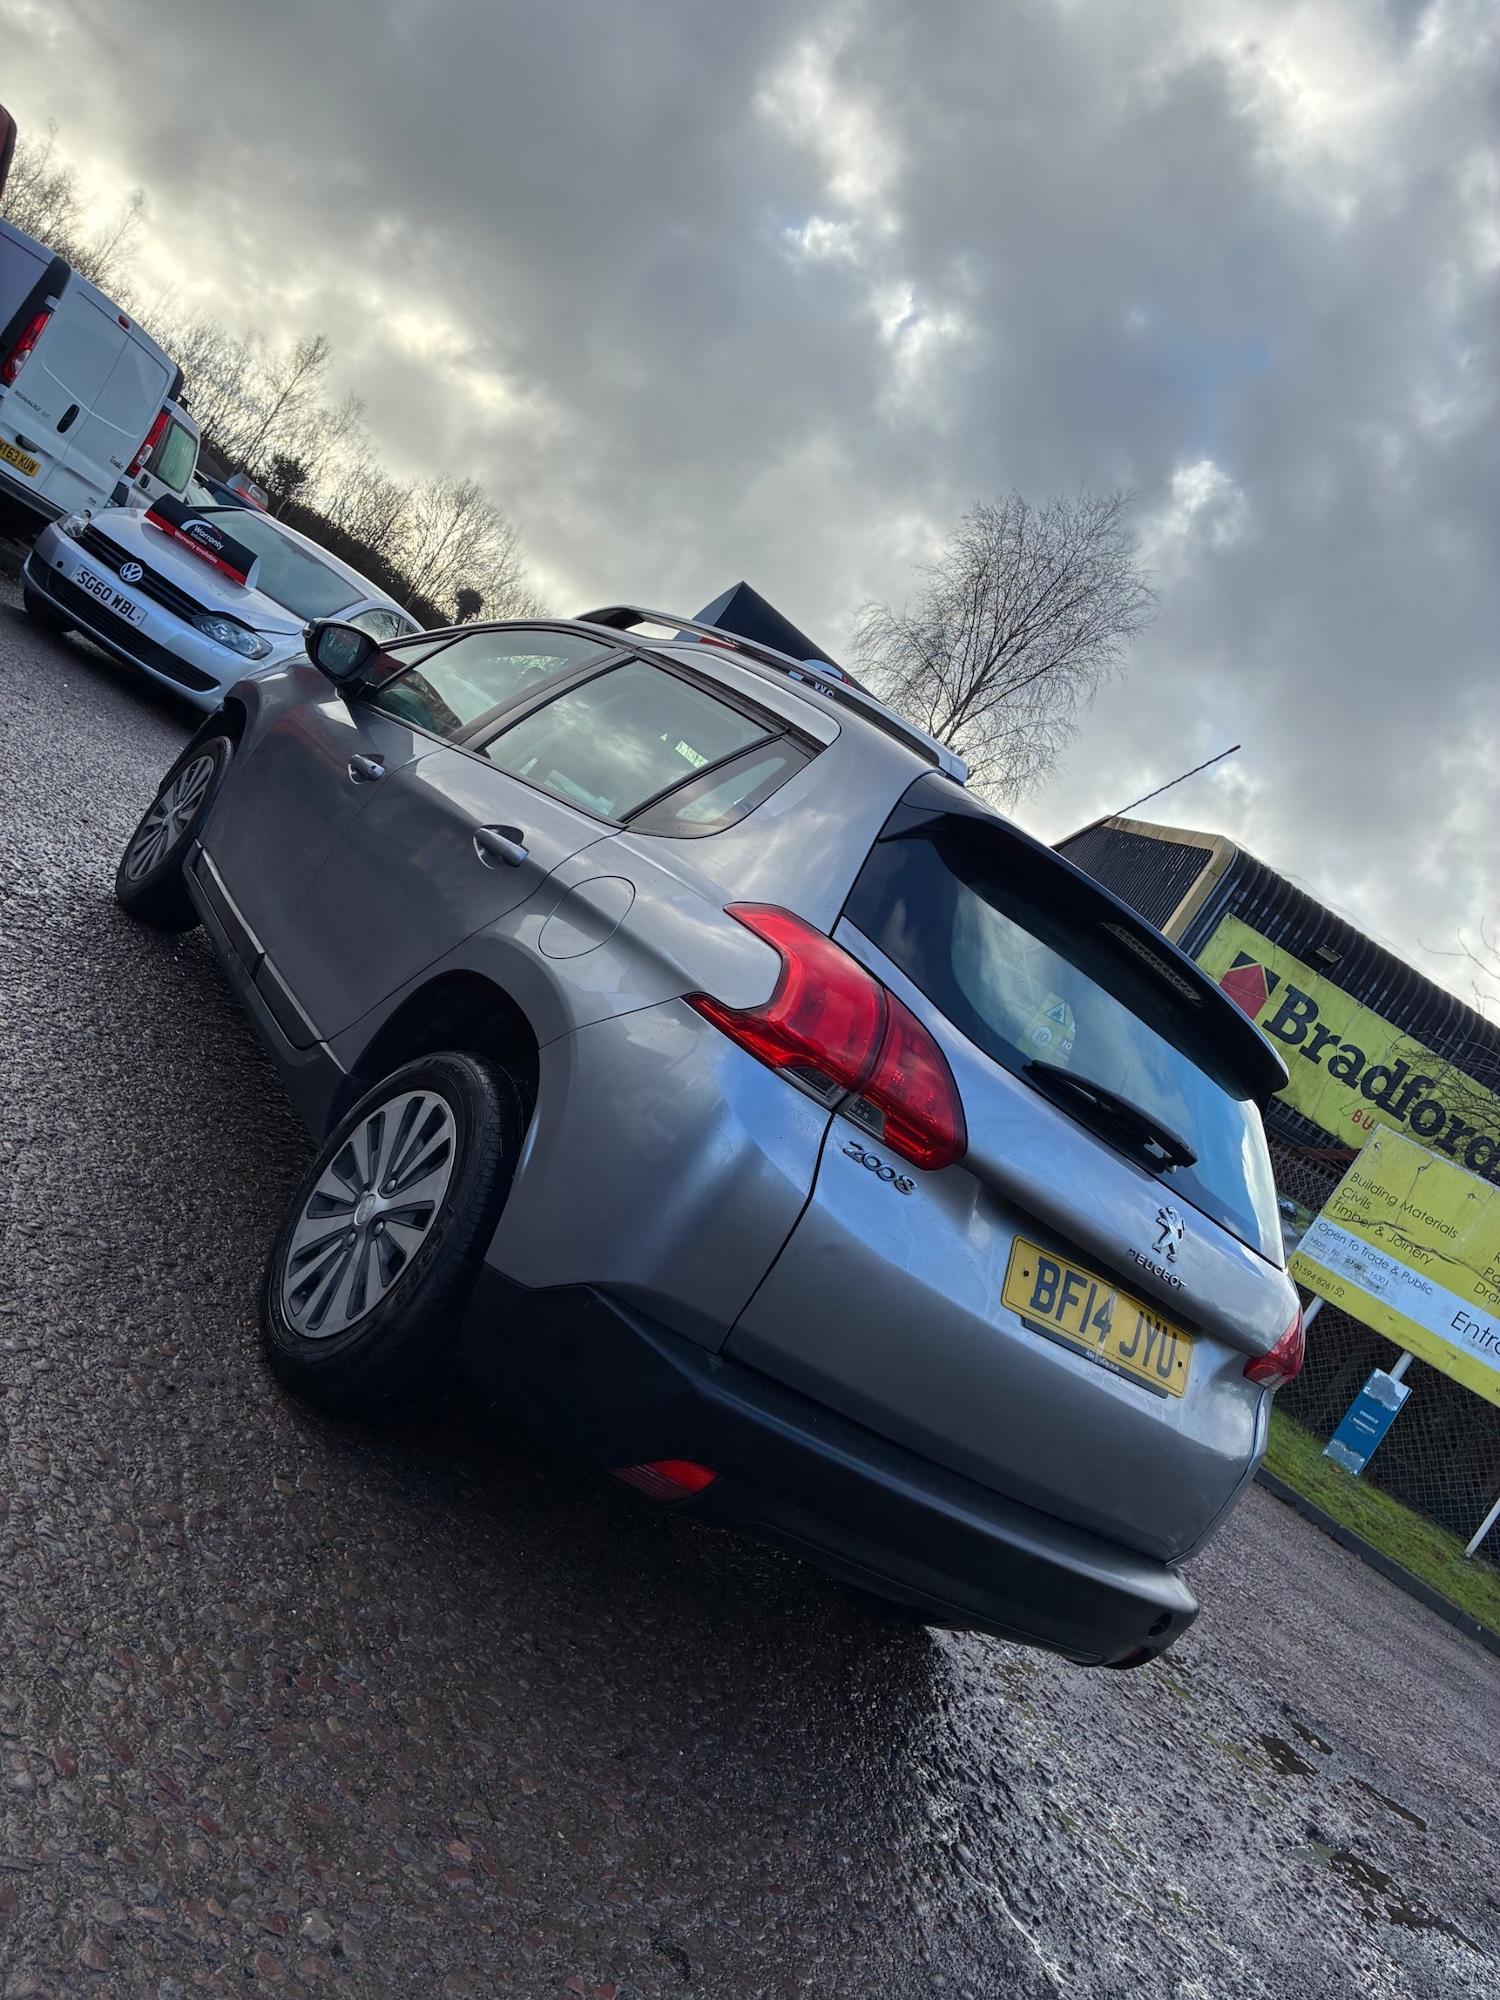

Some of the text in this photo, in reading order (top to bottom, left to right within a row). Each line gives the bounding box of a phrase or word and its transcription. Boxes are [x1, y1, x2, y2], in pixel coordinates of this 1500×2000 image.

[18, 455, 37, 473] KUW
[174, 530, 196, 549] Warranty
[196, 545, 218, 563] available
[194, 525, 224, 550] Warranty
[77, 570, 136, 621] SG60 WBL
[842, 1140, 918, 1196] 2008
[1341, 1187, 1373, 1210] Civils
[1350, 1172, 1459, 1239] Building Materials
[1309, 1236, 1327, 1250] Mon
[1330, 1248, 1340, 1257] Fri
[1331, 1200, 1434, 1265] Timber & Joinery
[1126, 1248, 1187, 1290] PEUGEOT
[1293, 1260, 1345, 1298] 01594 826152
[1318, 1222, 1434, 1295] Open To Trade & Public
[1029, 1256, 1178, 1379] BF14 JYU
